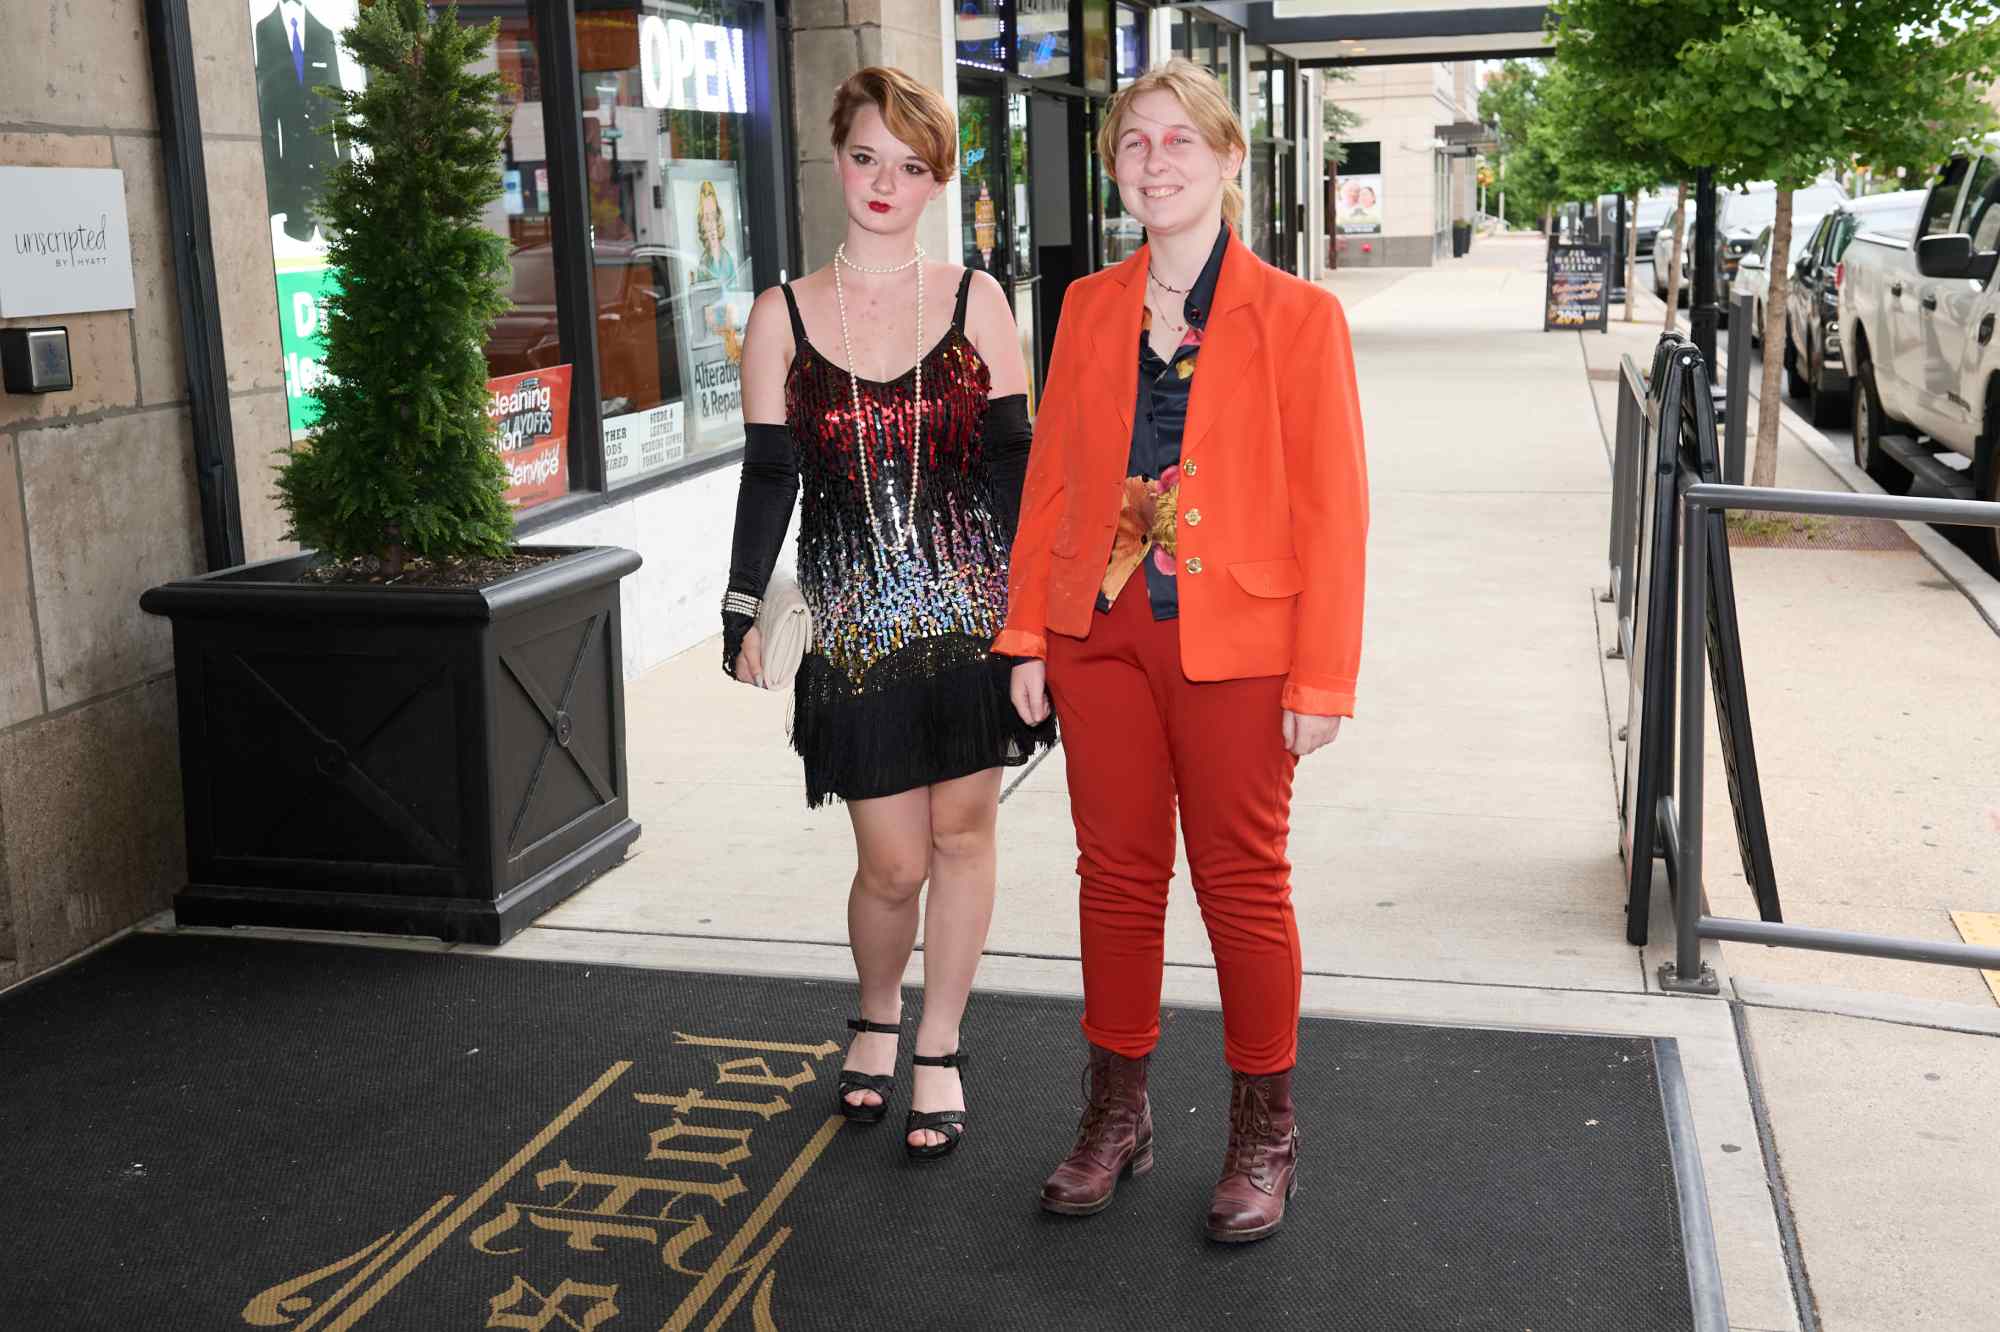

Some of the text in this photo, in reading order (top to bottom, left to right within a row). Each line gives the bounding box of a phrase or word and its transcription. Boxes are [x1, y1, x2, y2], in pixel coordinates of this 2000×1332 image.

[640, 15, 748, 114] OPEN
[14, 213, 107, 267] unscripted
[55, 257, 108, 267] BY HYATT
[486, 385, 551, 417] cleaning
[701, 392, 710, 417] &
[501, 410, 553, 436] PLAYOFFS
